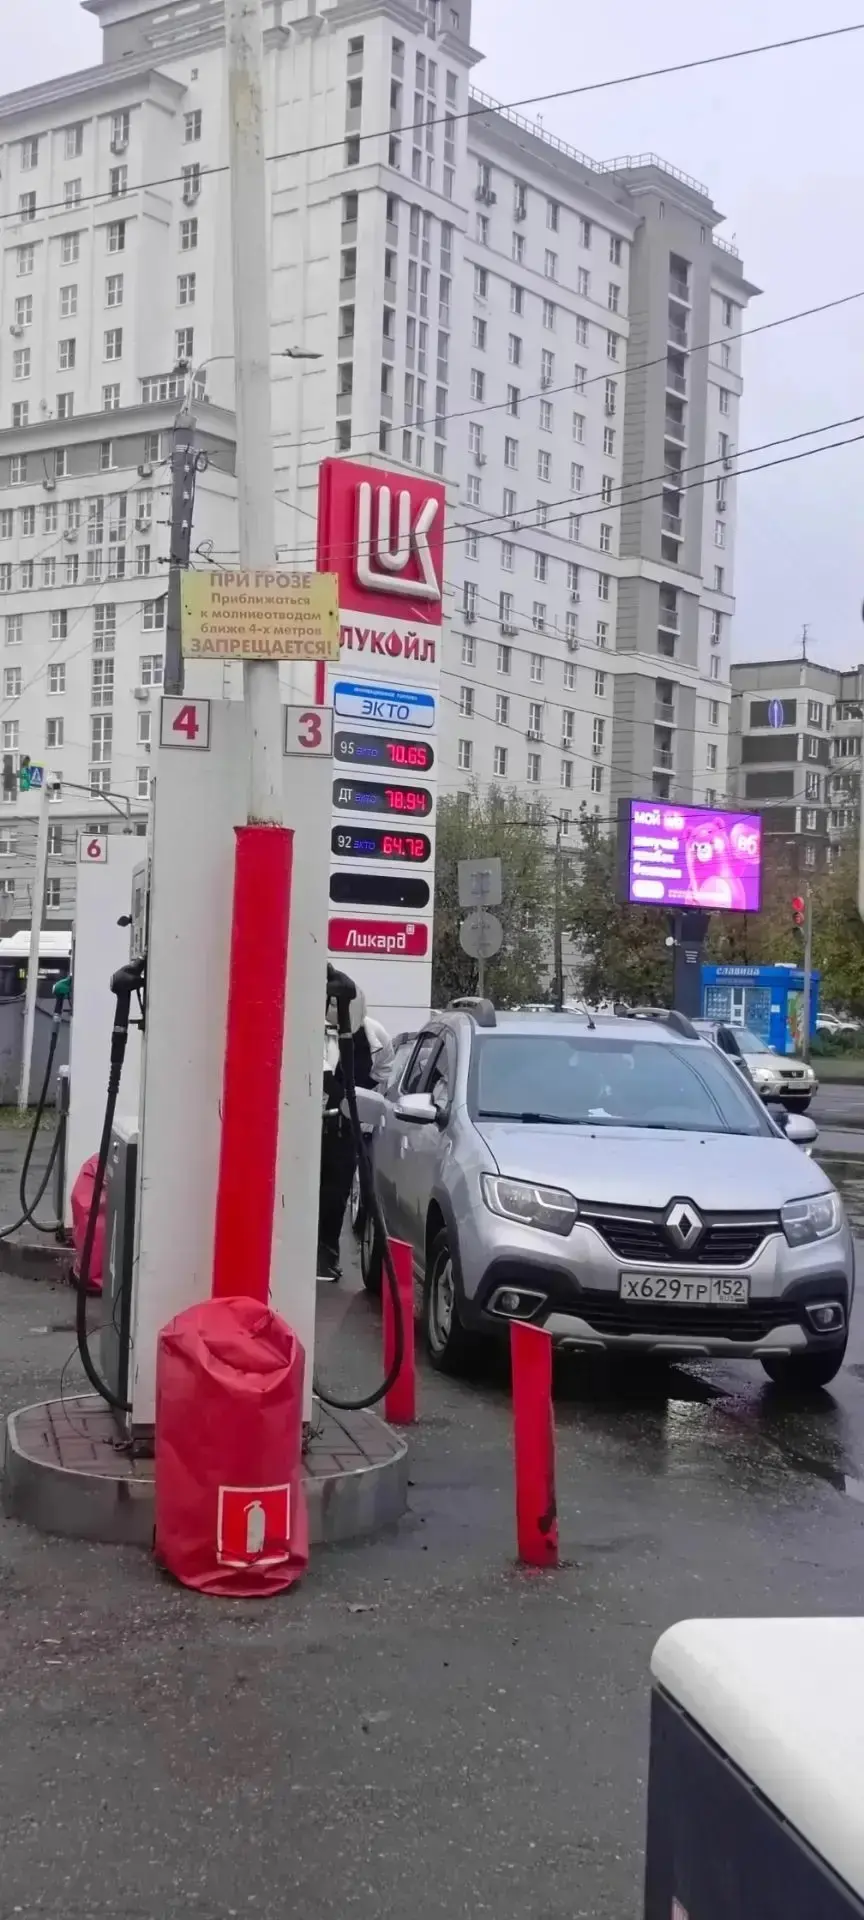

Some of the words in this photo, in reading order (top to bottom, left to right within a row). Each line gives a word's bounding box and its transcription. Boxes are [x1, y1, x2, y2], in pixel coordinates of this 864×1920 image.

[210, 573, 249, 587] ПРИ
[255, 573, 311, 589] ГРОЗЕ
[211, 592, 310, 606] Приближаться
[200, 610, 208, 618] к
[212, 610, 321, 621] молниеотводом
[200, 622, 245, 634] ближе
[249, 623, 271, 635] 4-х
[273, 625, 322, 637] метров
[191, 637, 332, 656] ЗАПРЕЩАЕТСЯ!
[339, 625, 436, 664] ЛУКОЙЛ
[361, 700, 410, 720] ЭКТО
[172, 705, 199, 740] 4
[297, 712, 322, 748] 3
[340, 741, 355, 754] 95
[386, 744, 427, 766] 70.65
[338, 788, 353, 803] ДТ
[384, 790, 426, 811] 78.94
[86, 838, 102, 858] 6
[337, 835, 352, 849] 92
[383, 836, 424, 857] 64.72
[345, 929, 406, 952] Ликард
[627, 1278, 708, 1301] Х629ТР
[713, 1280, 743, 1297] 152
